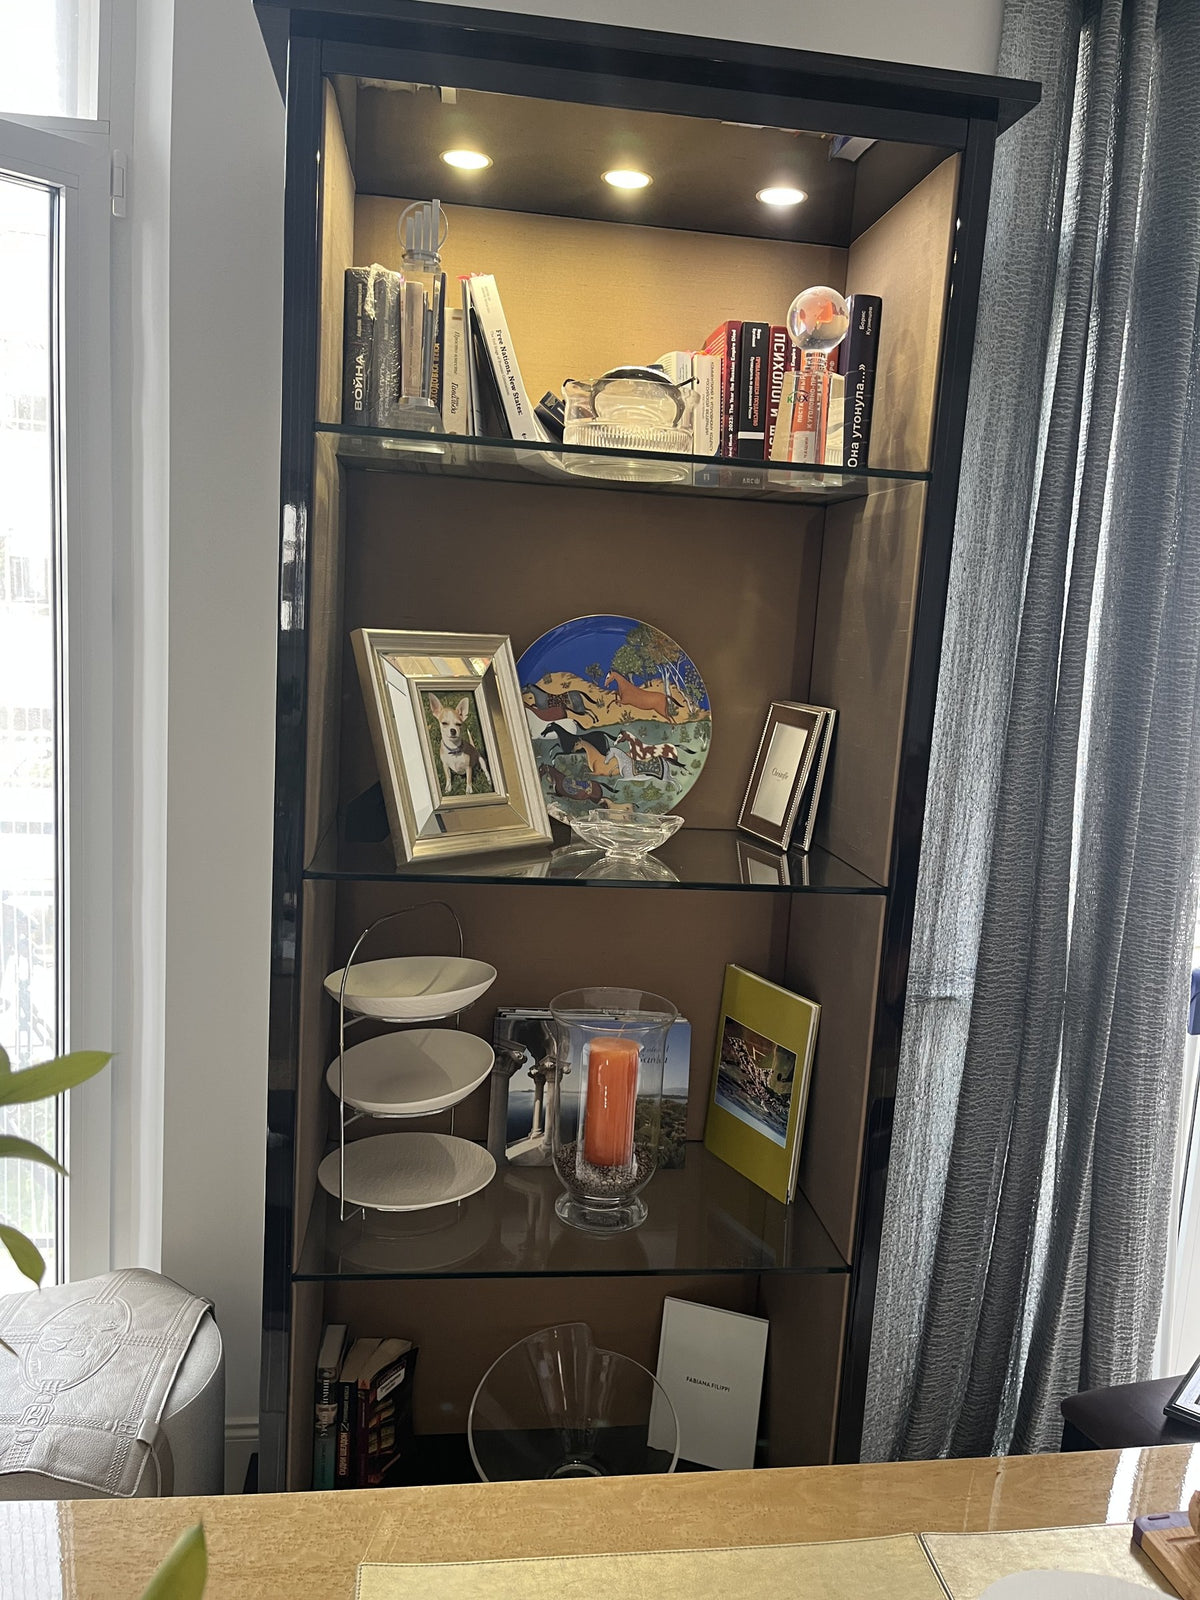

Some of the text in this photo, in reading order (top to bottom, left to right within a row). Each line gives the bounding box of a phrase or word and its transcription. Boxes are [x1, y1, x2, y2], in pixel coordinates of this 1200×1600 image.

[859, 311, 867, 330] Борис
[452, 331, 460, 353] Просто
[353, 353, 365, 411] ВОЙНА
[495, 328, 525, 416] Free Nations, New States:
[848, 364, 866, 468] Она утонула...»
[686, 1376, 731, 1393] FABIANA FILIPPI
